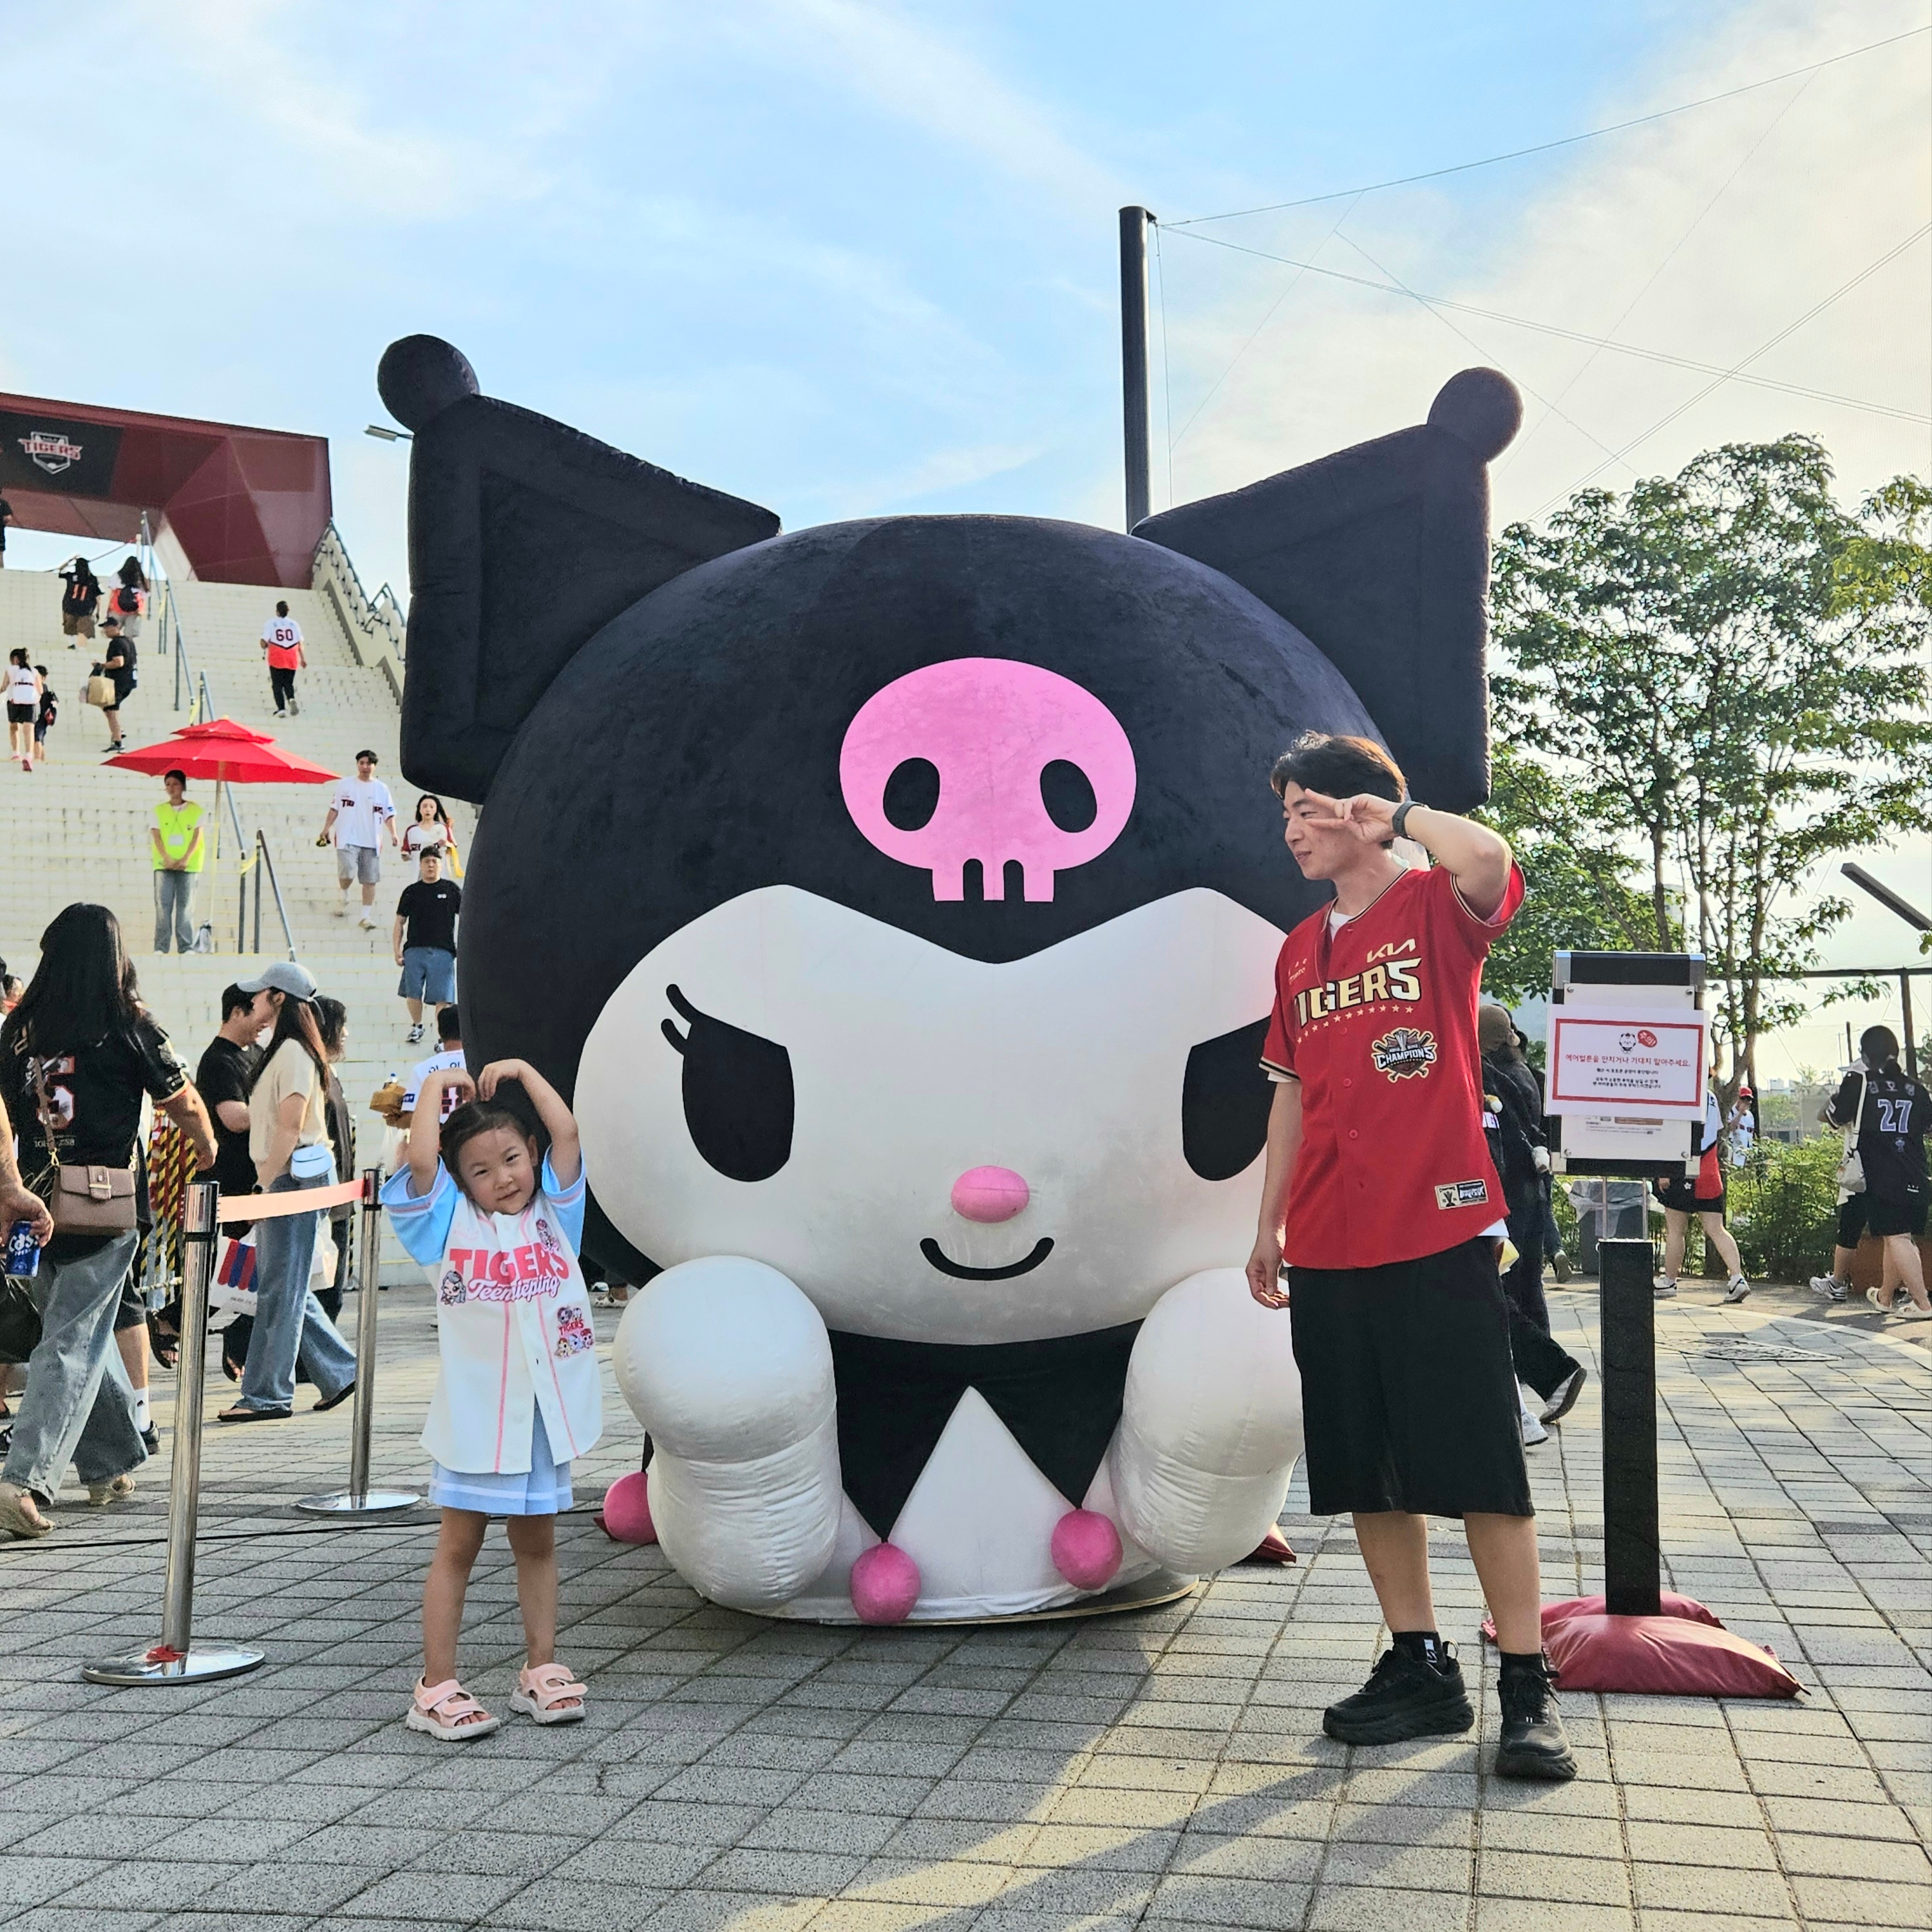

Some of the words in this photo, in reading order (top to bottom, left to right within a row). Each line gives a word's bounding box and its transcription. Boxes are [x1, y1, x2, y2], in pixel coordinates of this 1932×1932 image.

[17, 439, 83, 460] TIGERS
[71, 583, 88, 601] 11
[276, 629, 294, 641] 60
[1367, 938, 1417, 963] KIA
[1295, 956, 1422, 1028] IGERS
[1376, 1045, 1435, 1069] CHAMPIONS
[1602, 1056, 1629, 1064] 만지거나
[1877, 1099, 1913, 1133] 27
[450, 1242, 569, 1285] TIGERS
[559, 1319, 584, 1336] TIGERS
